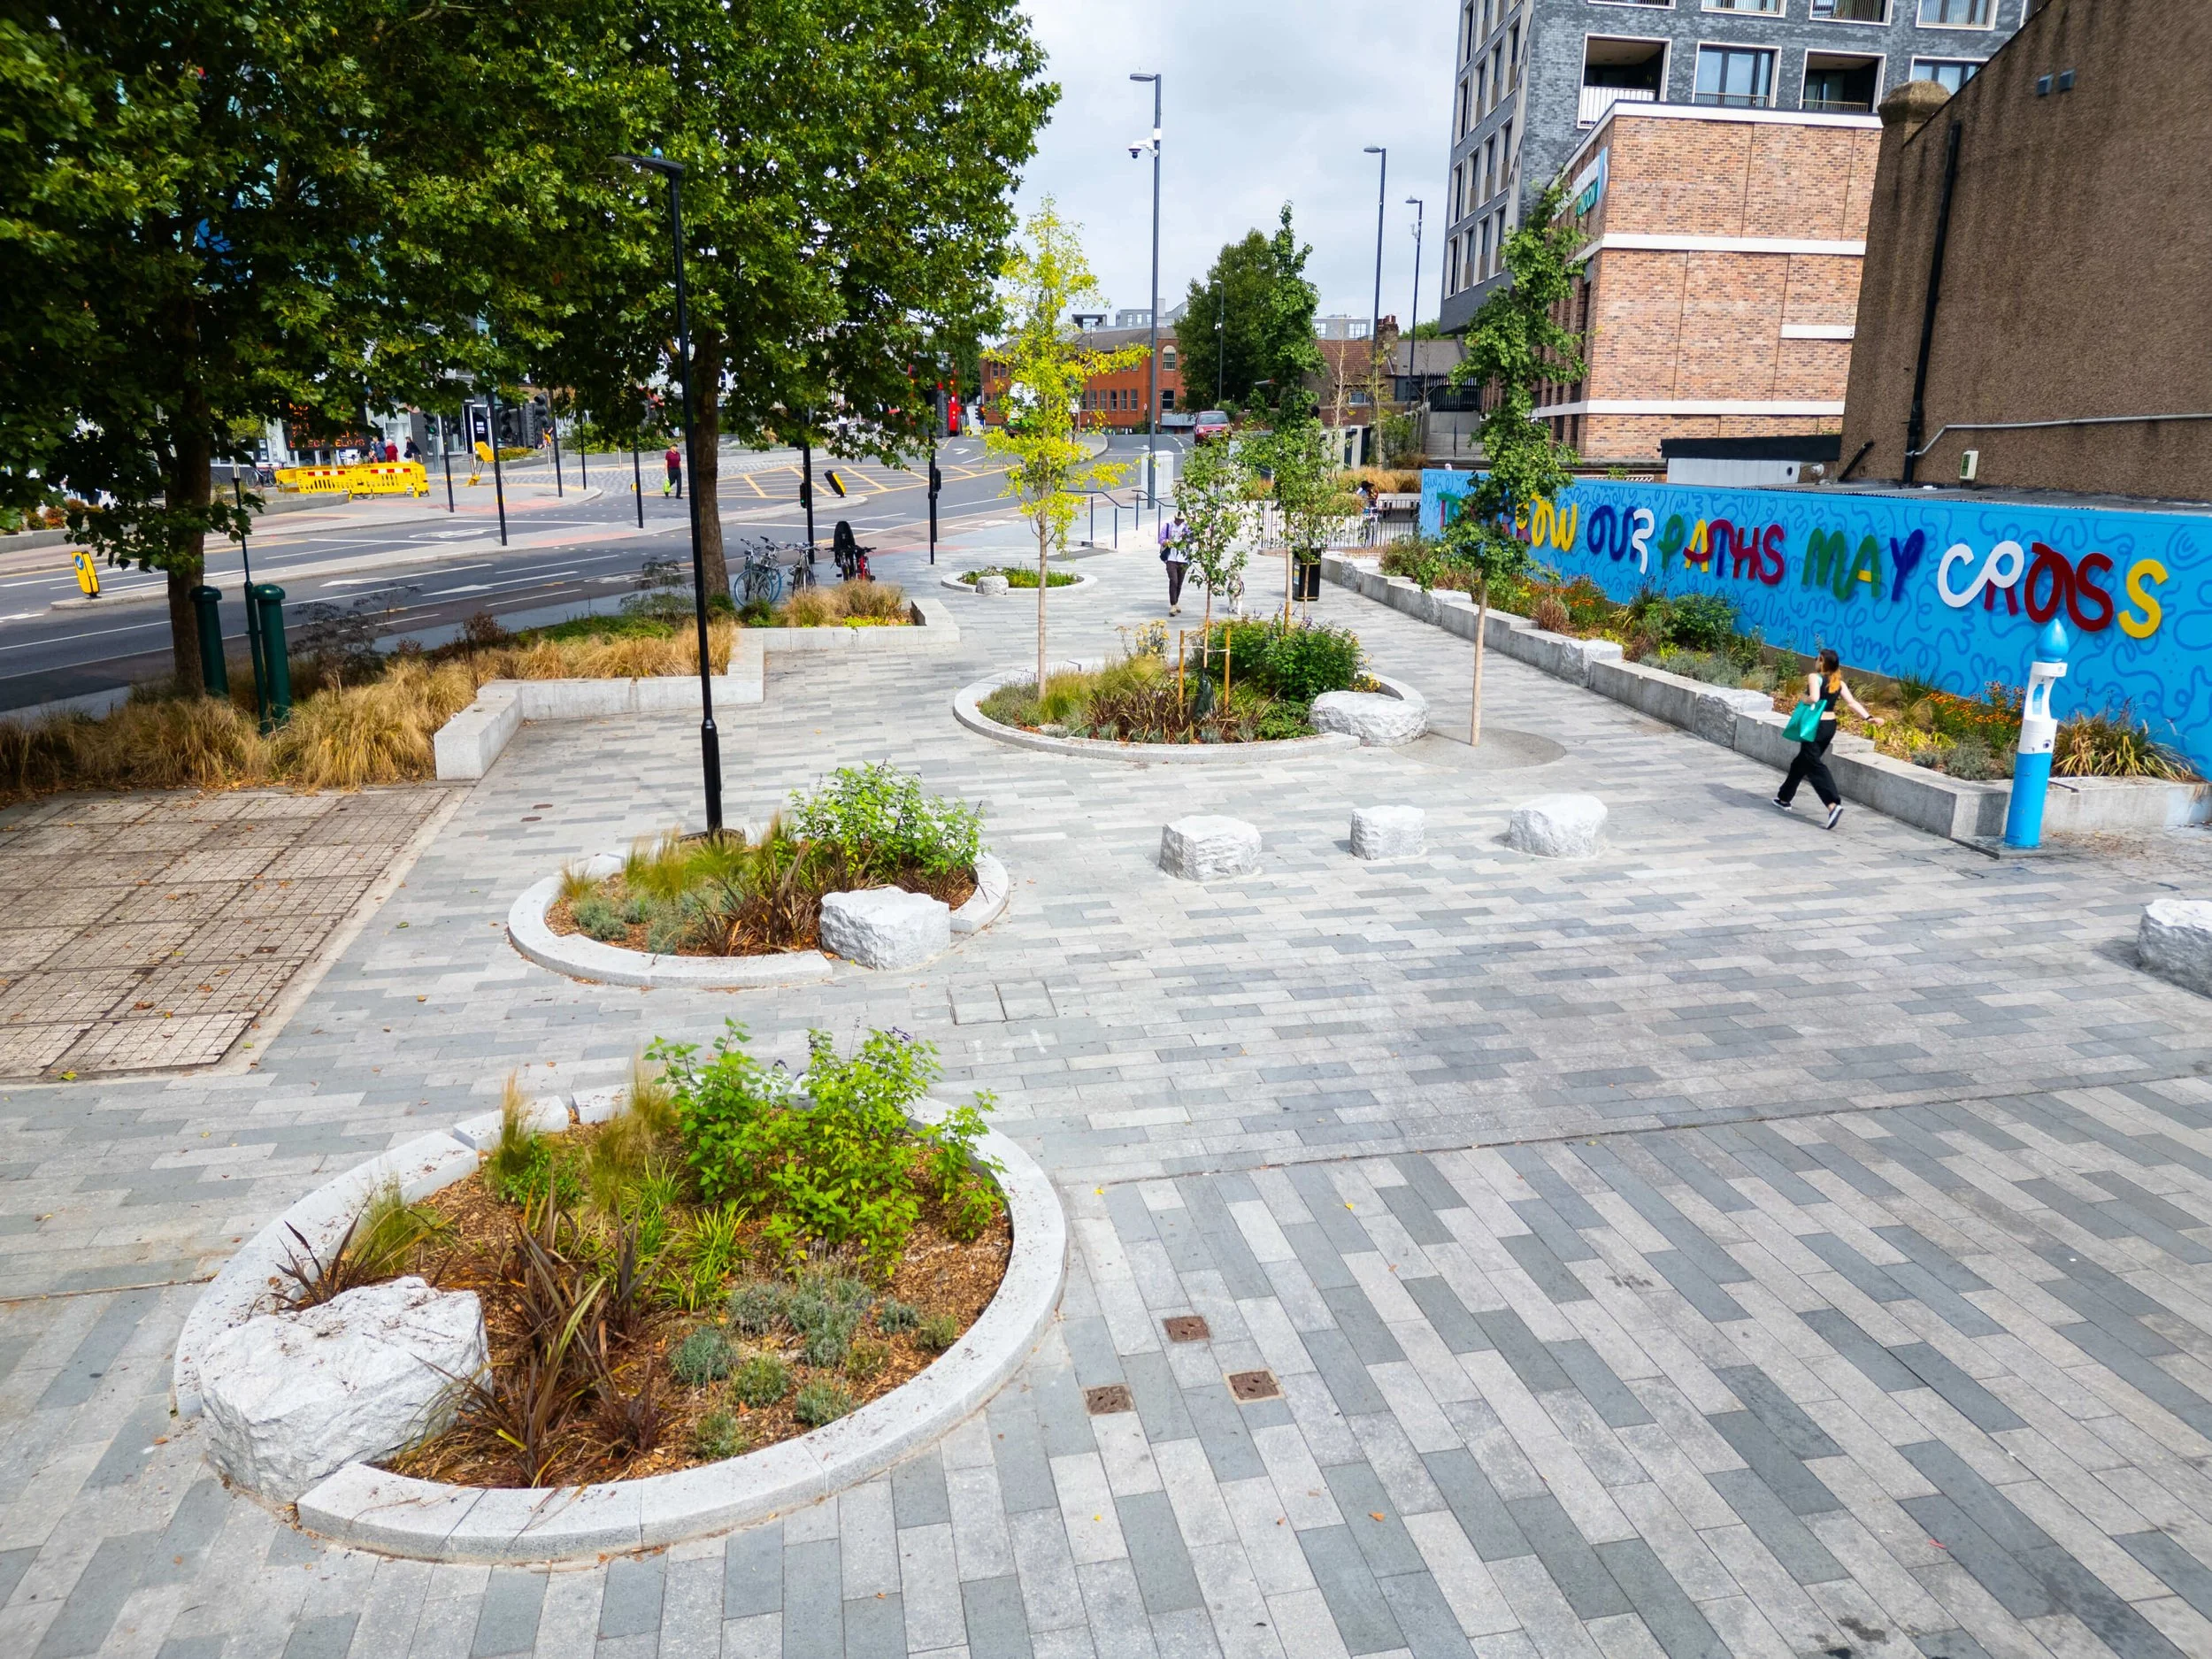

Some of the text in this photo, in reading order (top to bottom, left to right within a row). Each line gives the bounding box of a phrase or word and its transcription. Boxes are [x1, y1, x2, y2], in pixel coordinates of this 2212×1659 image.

[1586, 504, 1655, 574] OUR
[1657, 513, 1786, 586] PATHS
[1801, 527, 1924, 602] MAY
[1937, 540, 2170, 639] CROSS
